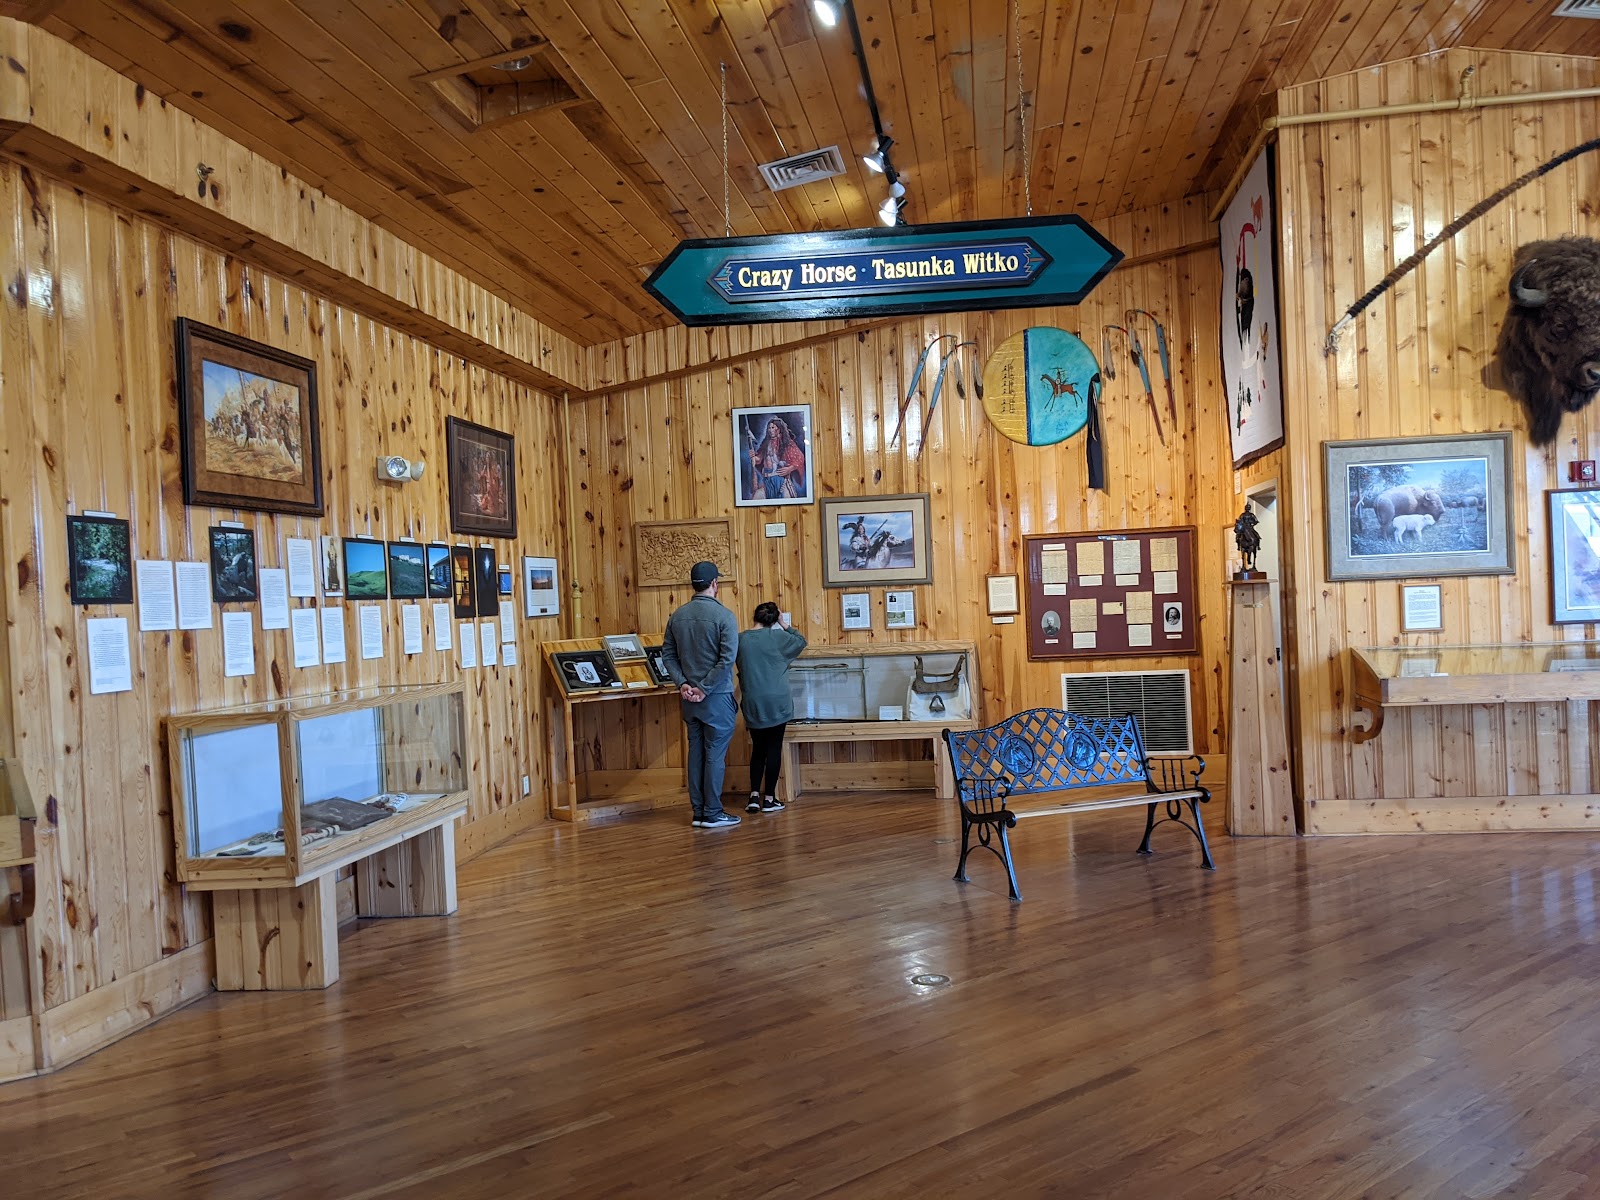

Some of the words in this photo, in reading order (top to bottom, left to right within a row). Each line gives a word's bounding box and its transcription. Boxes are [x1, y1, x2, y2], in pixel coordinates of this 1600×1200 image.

[738, 267, 793, 290] Crazy
[801, 263, 856, 284] Horse
[871, 256, 955, 279] Tasunka
[963, 252, 1019, 273] Witko
